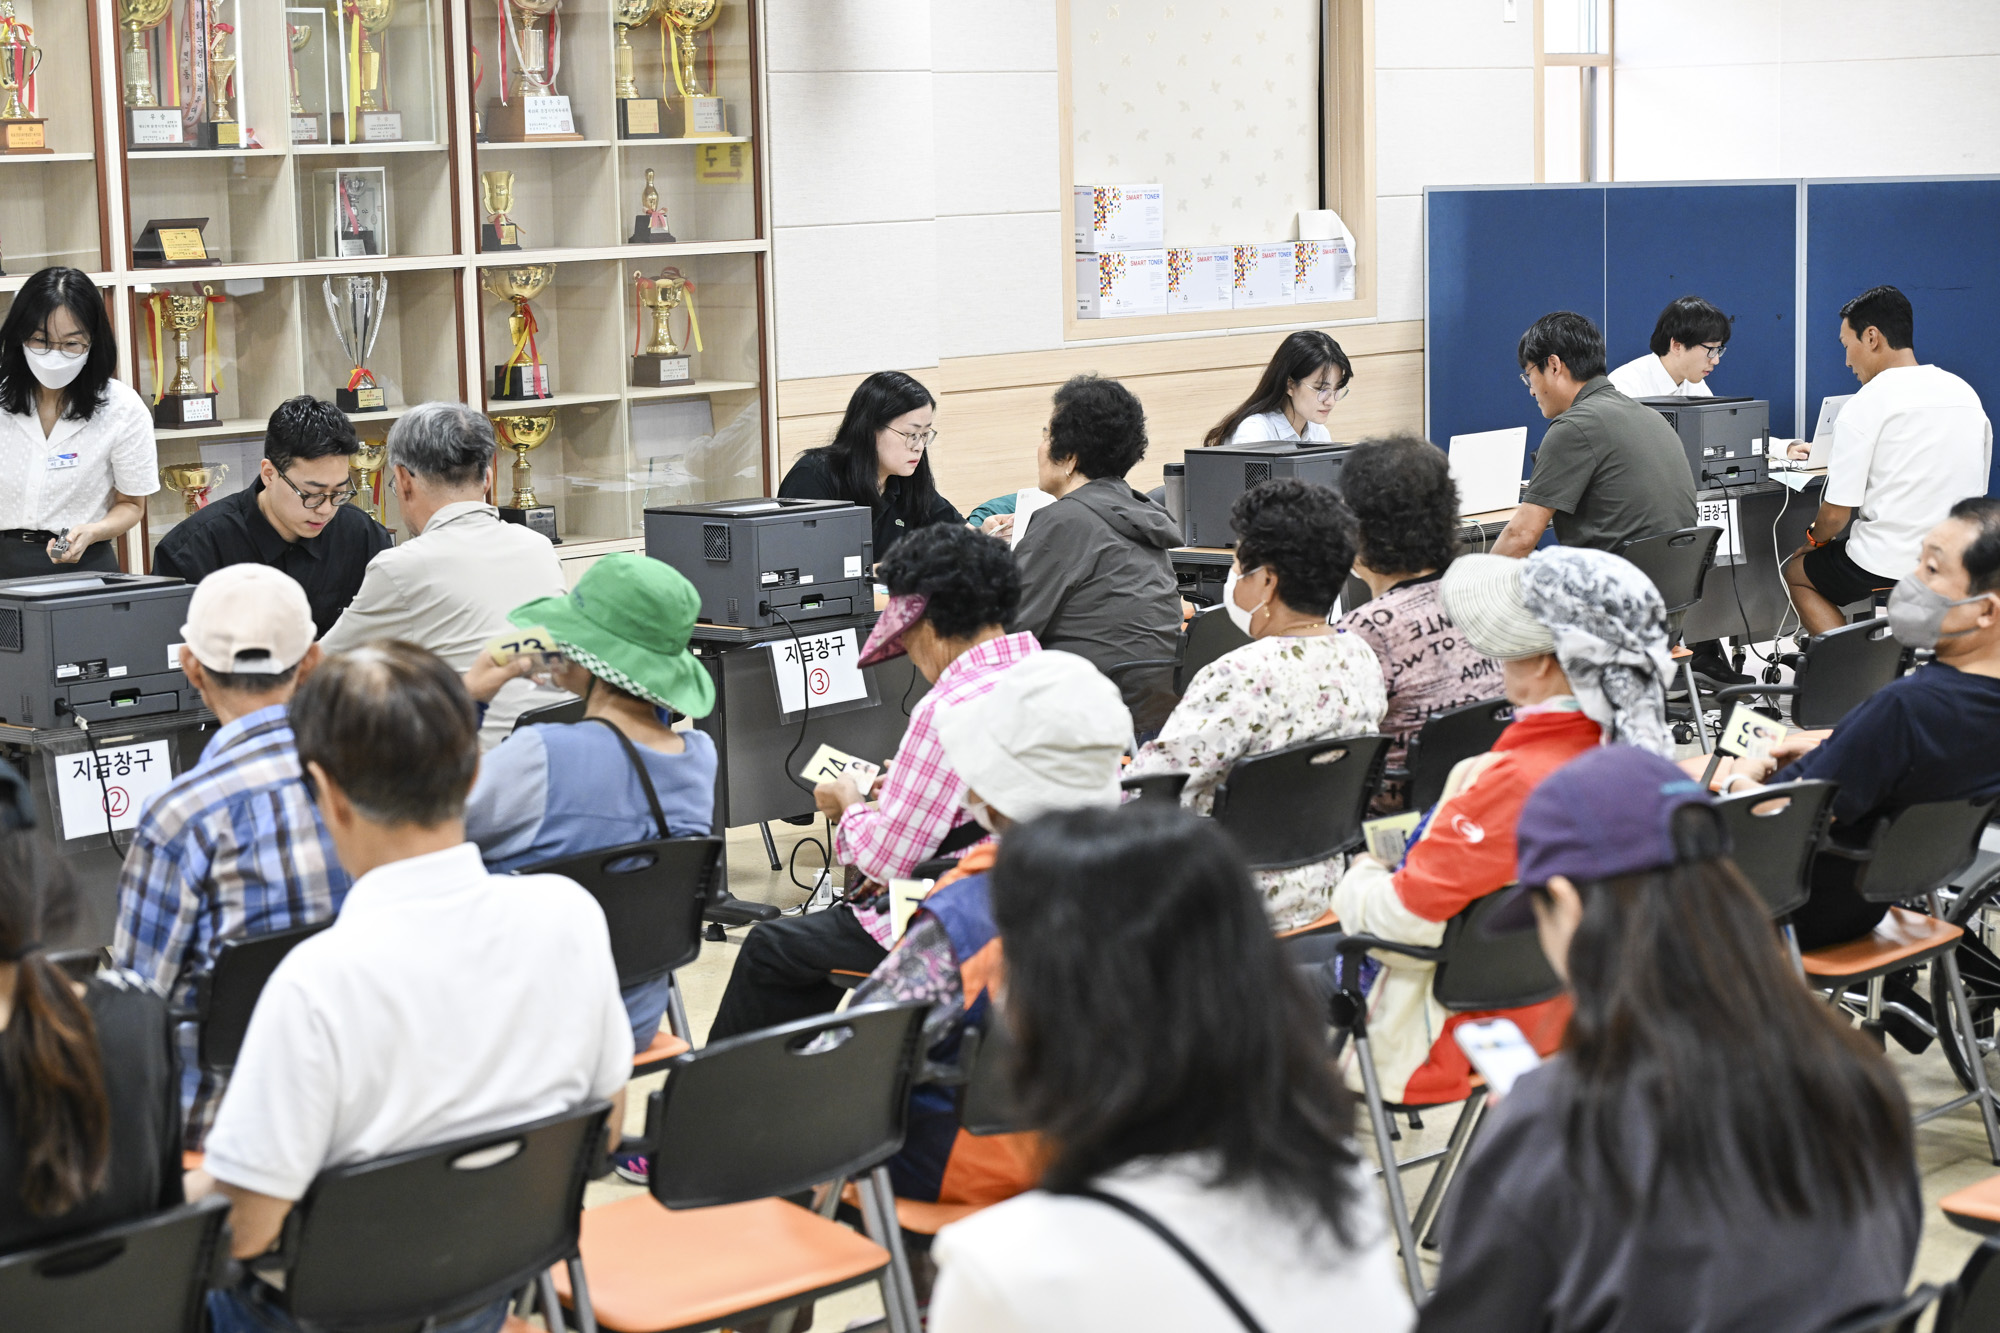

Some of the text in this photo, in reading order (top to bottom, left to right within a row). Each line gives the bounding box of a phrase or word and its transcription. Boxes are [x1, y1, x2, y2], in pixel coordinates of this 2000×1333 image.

[1148, 258, 1164, 266] TONER
[784, 635, 846, 664] 지급창구
[73, 748, 154, 781] 지급창구
